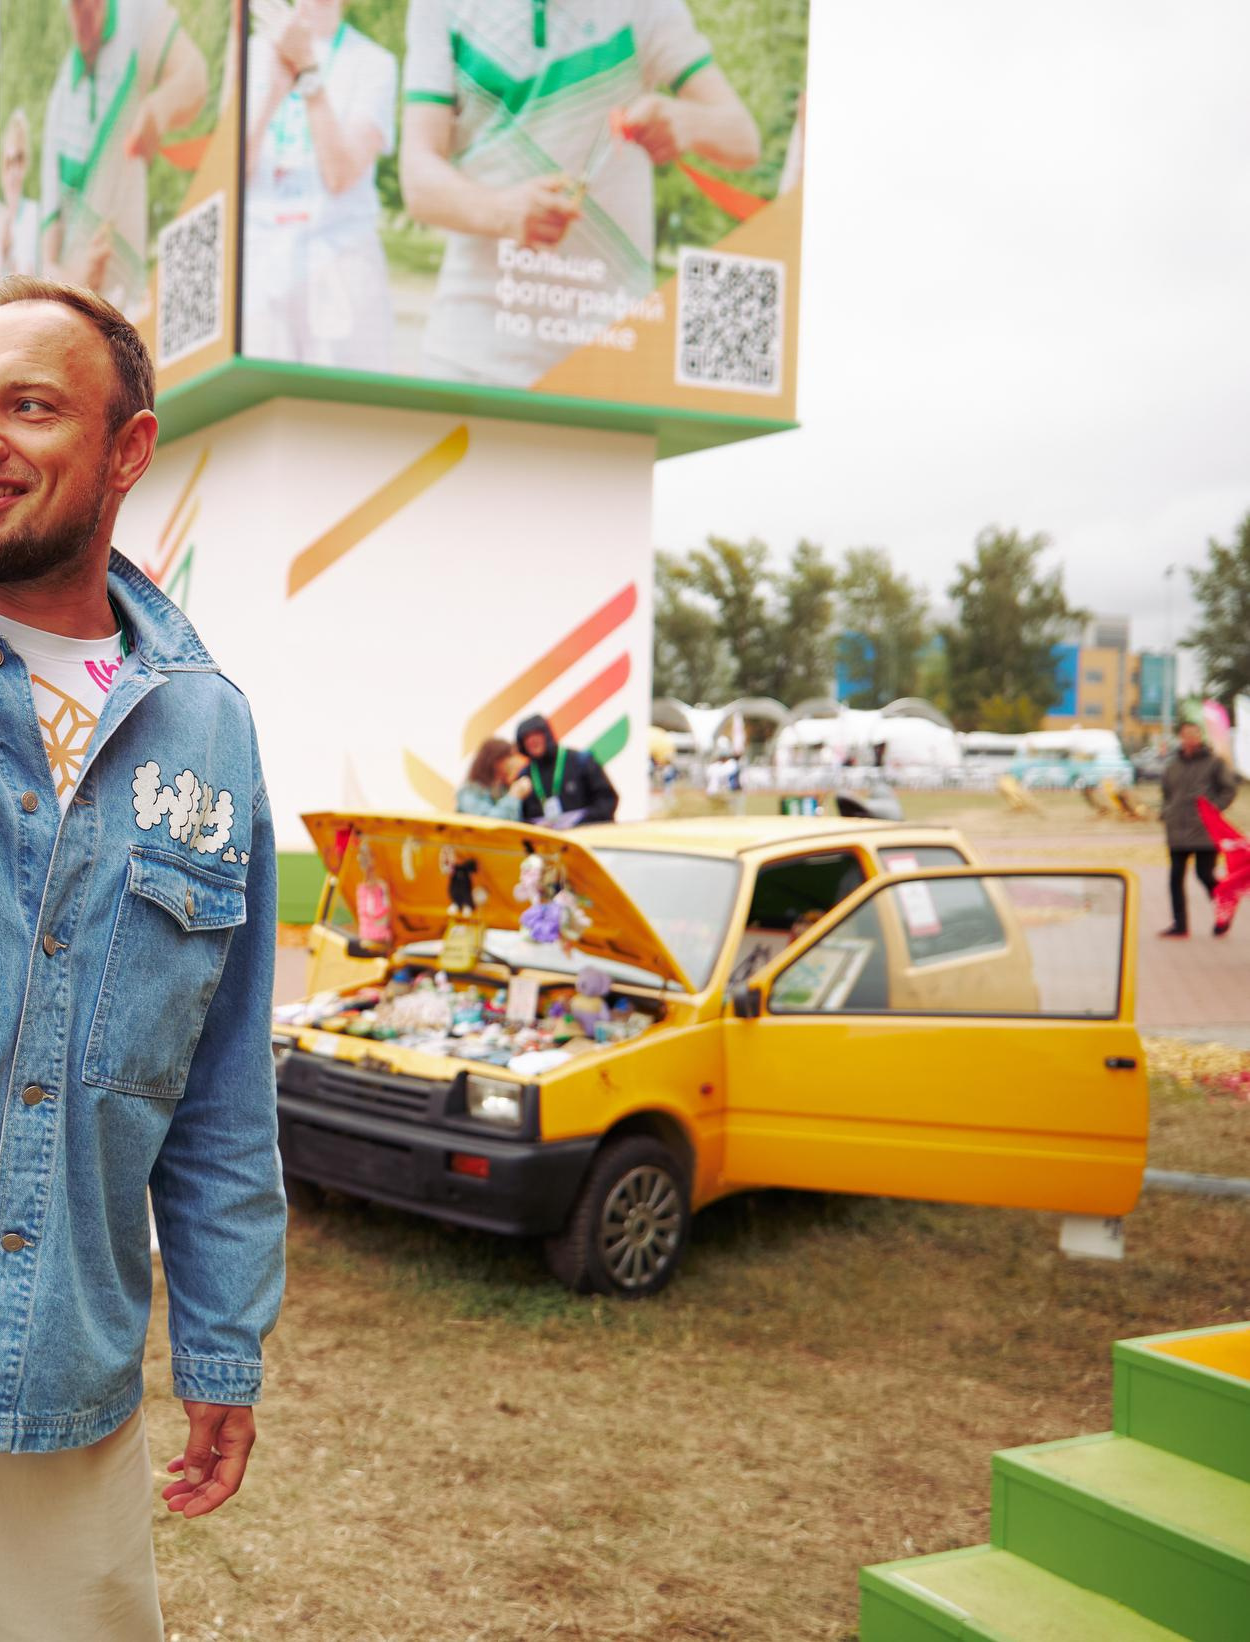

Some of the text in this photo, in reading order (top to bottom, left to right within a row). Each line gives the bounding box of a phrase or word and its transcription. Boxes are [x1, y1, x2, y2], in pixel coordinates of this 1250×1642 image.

[497, 237, 607, 281] Больше
[495, 272, 666, 322] фотографий
[495, 310, 533, 338] по
